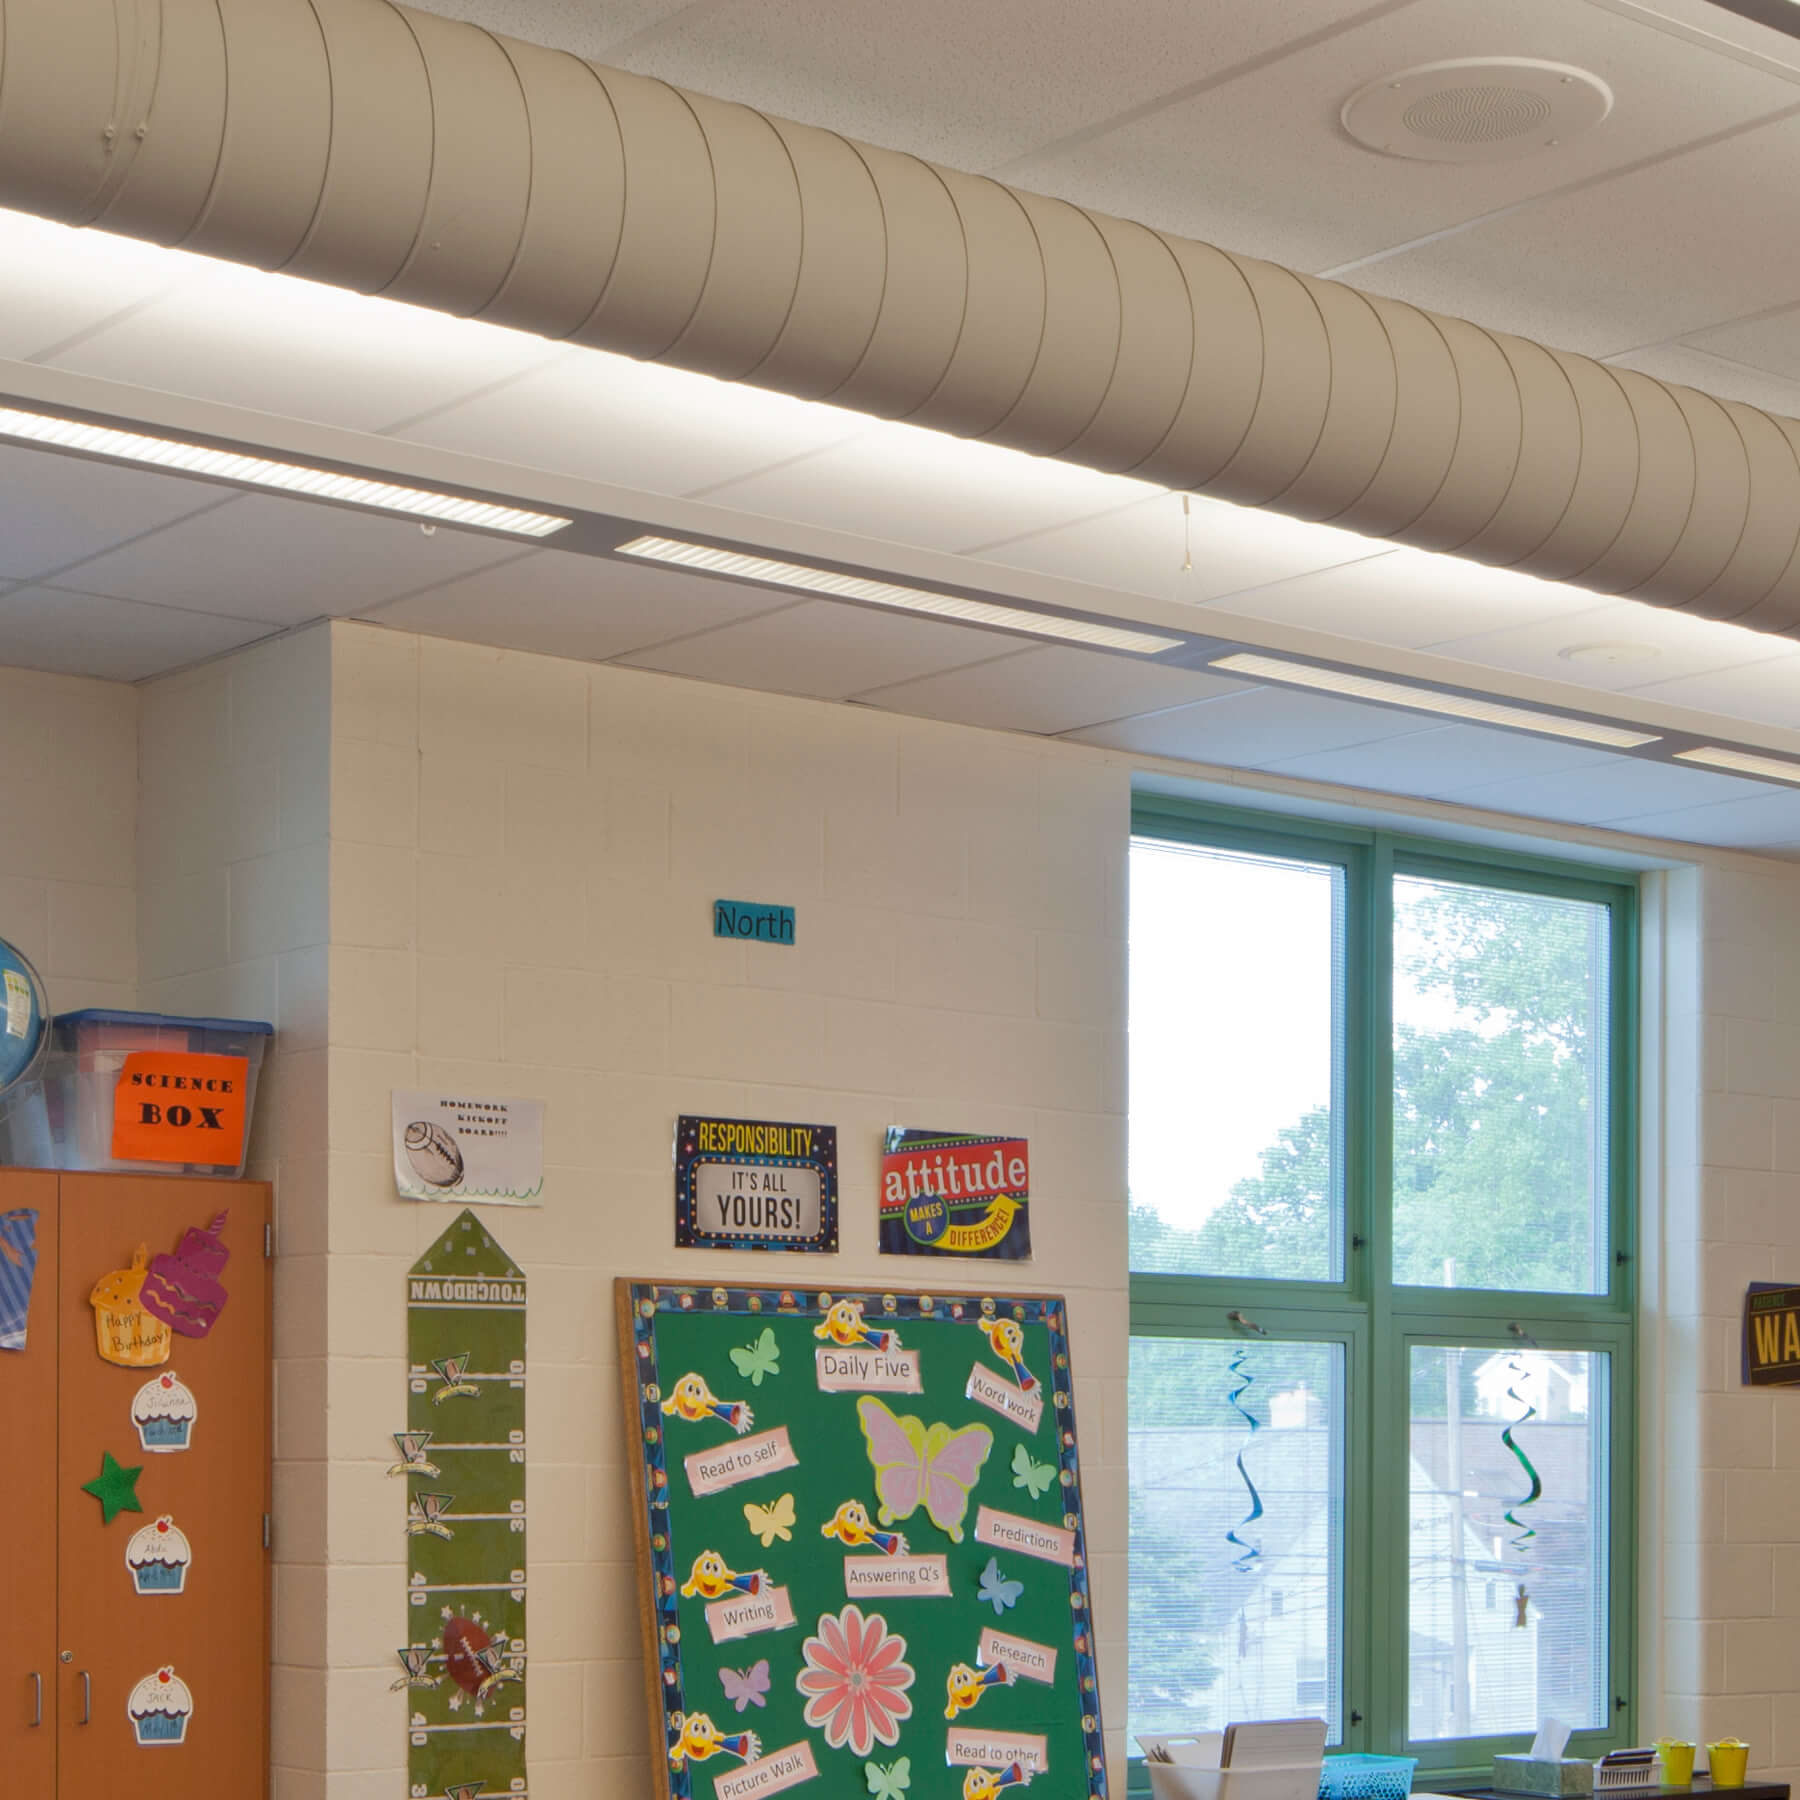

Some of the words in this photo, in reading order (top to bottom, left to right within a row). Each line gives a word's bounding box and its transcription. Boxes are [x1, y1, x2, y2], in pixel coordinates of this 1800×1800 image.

[717, 905, 795, 941] North
[130, 1071, 234, 1094] SCIENCE
[137, 1102, 225, 1131] BOX
[440, 1100, 508, 1112] HOMEWORK
[698, 1121, 813, 1158] RESPONSIBILITY
[731, 1172, 758, 1192] IT'S
[762, 1173, 787, 1193] ALL
[885, 1149, 1027, 1202] attitude
[717, 1196, 801, 1231] YOURS!
[909, 1204, 943, 1224] MAKES
[925, 1222, 933, 1236] A
[949, 1208, 1010, 1248] DIFFERENCE!
[411, 1281, 525, 1302] TOUCHDOWN
[106, 1311, 142, 1328] Happy
[112, 1328, 168, 1352] Birthday!
[824, 1354, 868, 1381] Daily
[875, 1357, 911, 1378] Five
[973, 1376, 1006, 1409] Word
[1006, 1396, 1037, 1423] work
[699, 1456, 735, 1481] Read
[737, 1453, 751, 1468] to
[752, 1442, 778, 1465] self
[992, 1522, 1059, 1552] Predictions
[849, 1567, 916, 1586] Answering
[918, 1565, 939, 1584] Q's
[723, 1603, 775, 1628] Writing
[990, 1639, 1047, 1669] Research
[955, 1743, 986, 1760] Read
[989, 1745, 1003, 1761] to
[722, 1771, 768, 1800] Picture
[770, 1754, 804, 1780] Walk
